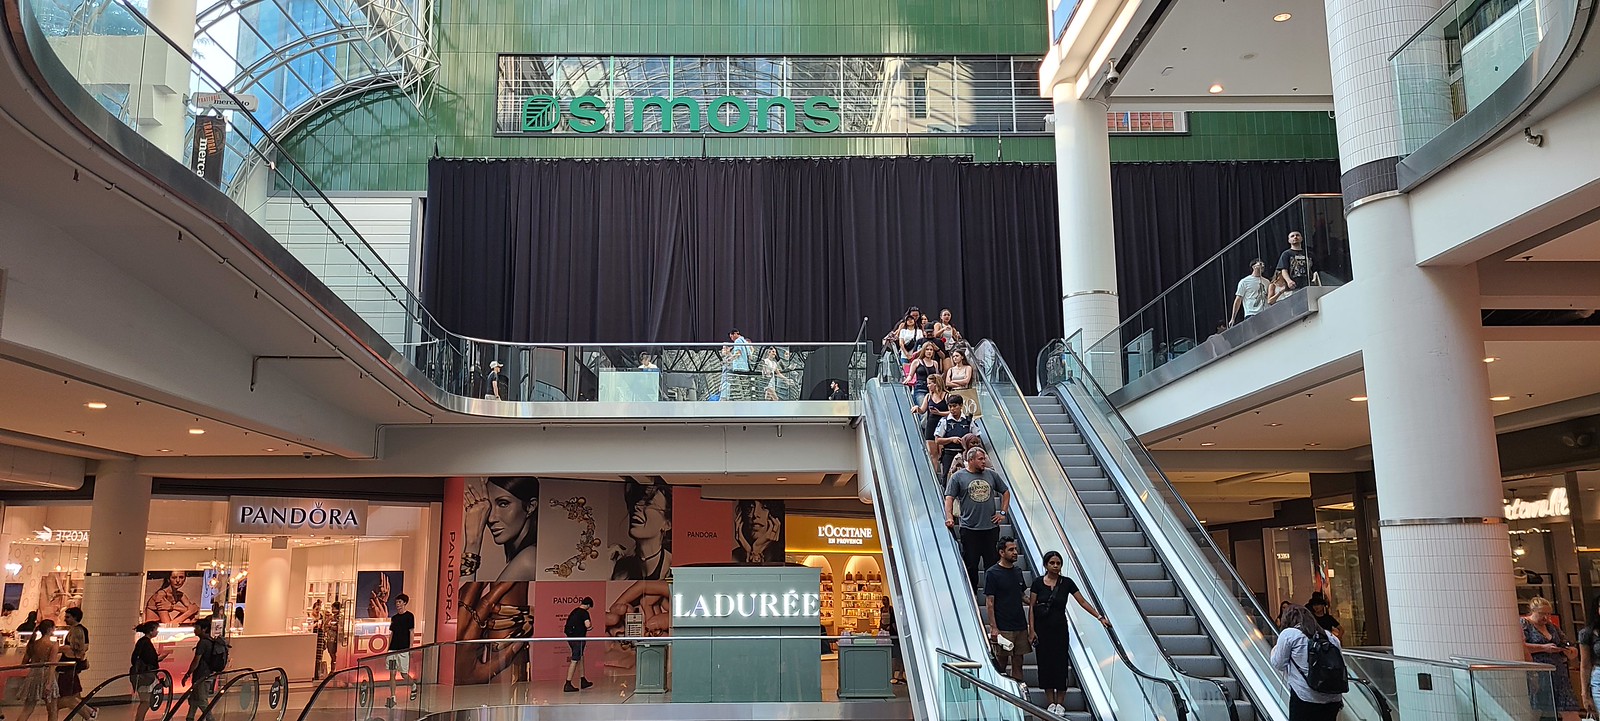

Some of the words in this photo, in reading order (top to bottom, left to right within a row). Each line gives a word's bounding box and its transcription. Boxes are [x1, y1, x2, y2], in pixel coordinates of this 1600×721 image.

[568, 94, 841, 133] simons
[240, 505, 359, 526] PANDORA
[817, 524, 873, 538] L'OCCITANE
[445, 531, 456, 625] PANDORA
[553, 596, 584, 604] PANDOR
[672, 589, 821, 618] LADURÉE
[153, 695, 160, 708] 2
[271, 693, 277, 706] 2
